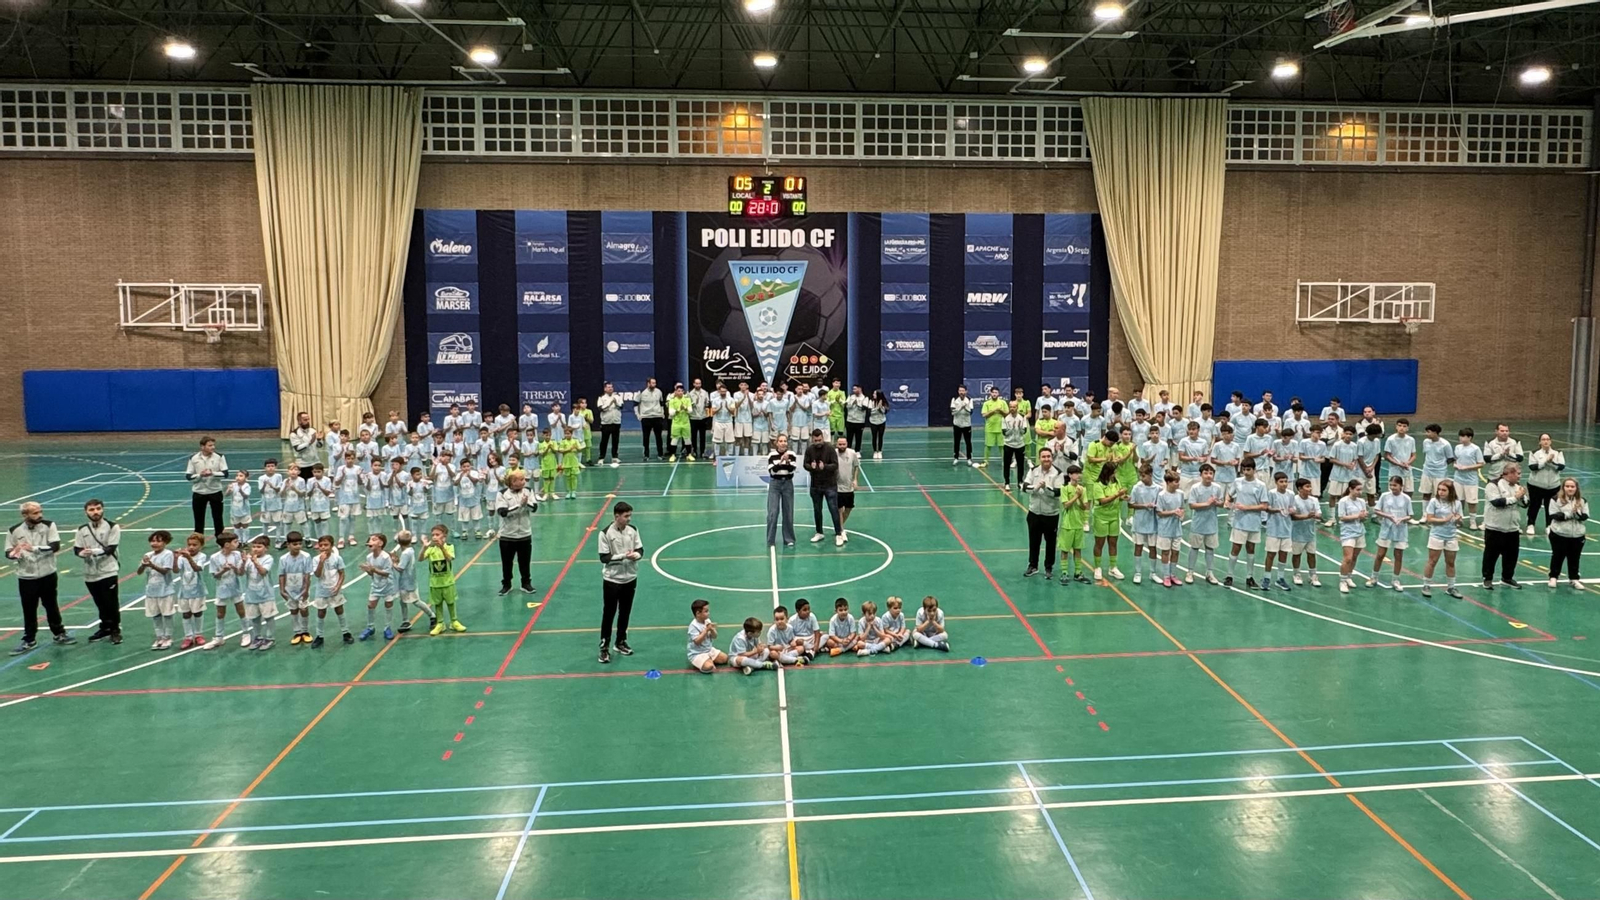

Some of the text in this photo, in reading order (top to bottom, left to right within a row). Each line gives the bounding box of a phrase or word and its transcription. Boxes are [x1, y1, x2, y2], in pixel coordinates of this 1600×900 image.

[735, 176, 752, 190] 05
[785, 177, 803, 191] 01
[763, 184, 772, 194] 2
[730, 201, 743, 211] 00
[792, 202, 805, 212] 00
[701, 228, 835, 248] POLI EJIDO CF
[606, 241, 636, 250] Almagro
[967, 293, 1008, 303] MRW
[436, 301, 471, 310] MARSER
[703, 346, 731, 360] imd
[790, 365, 828, 374] EL EJIDO
